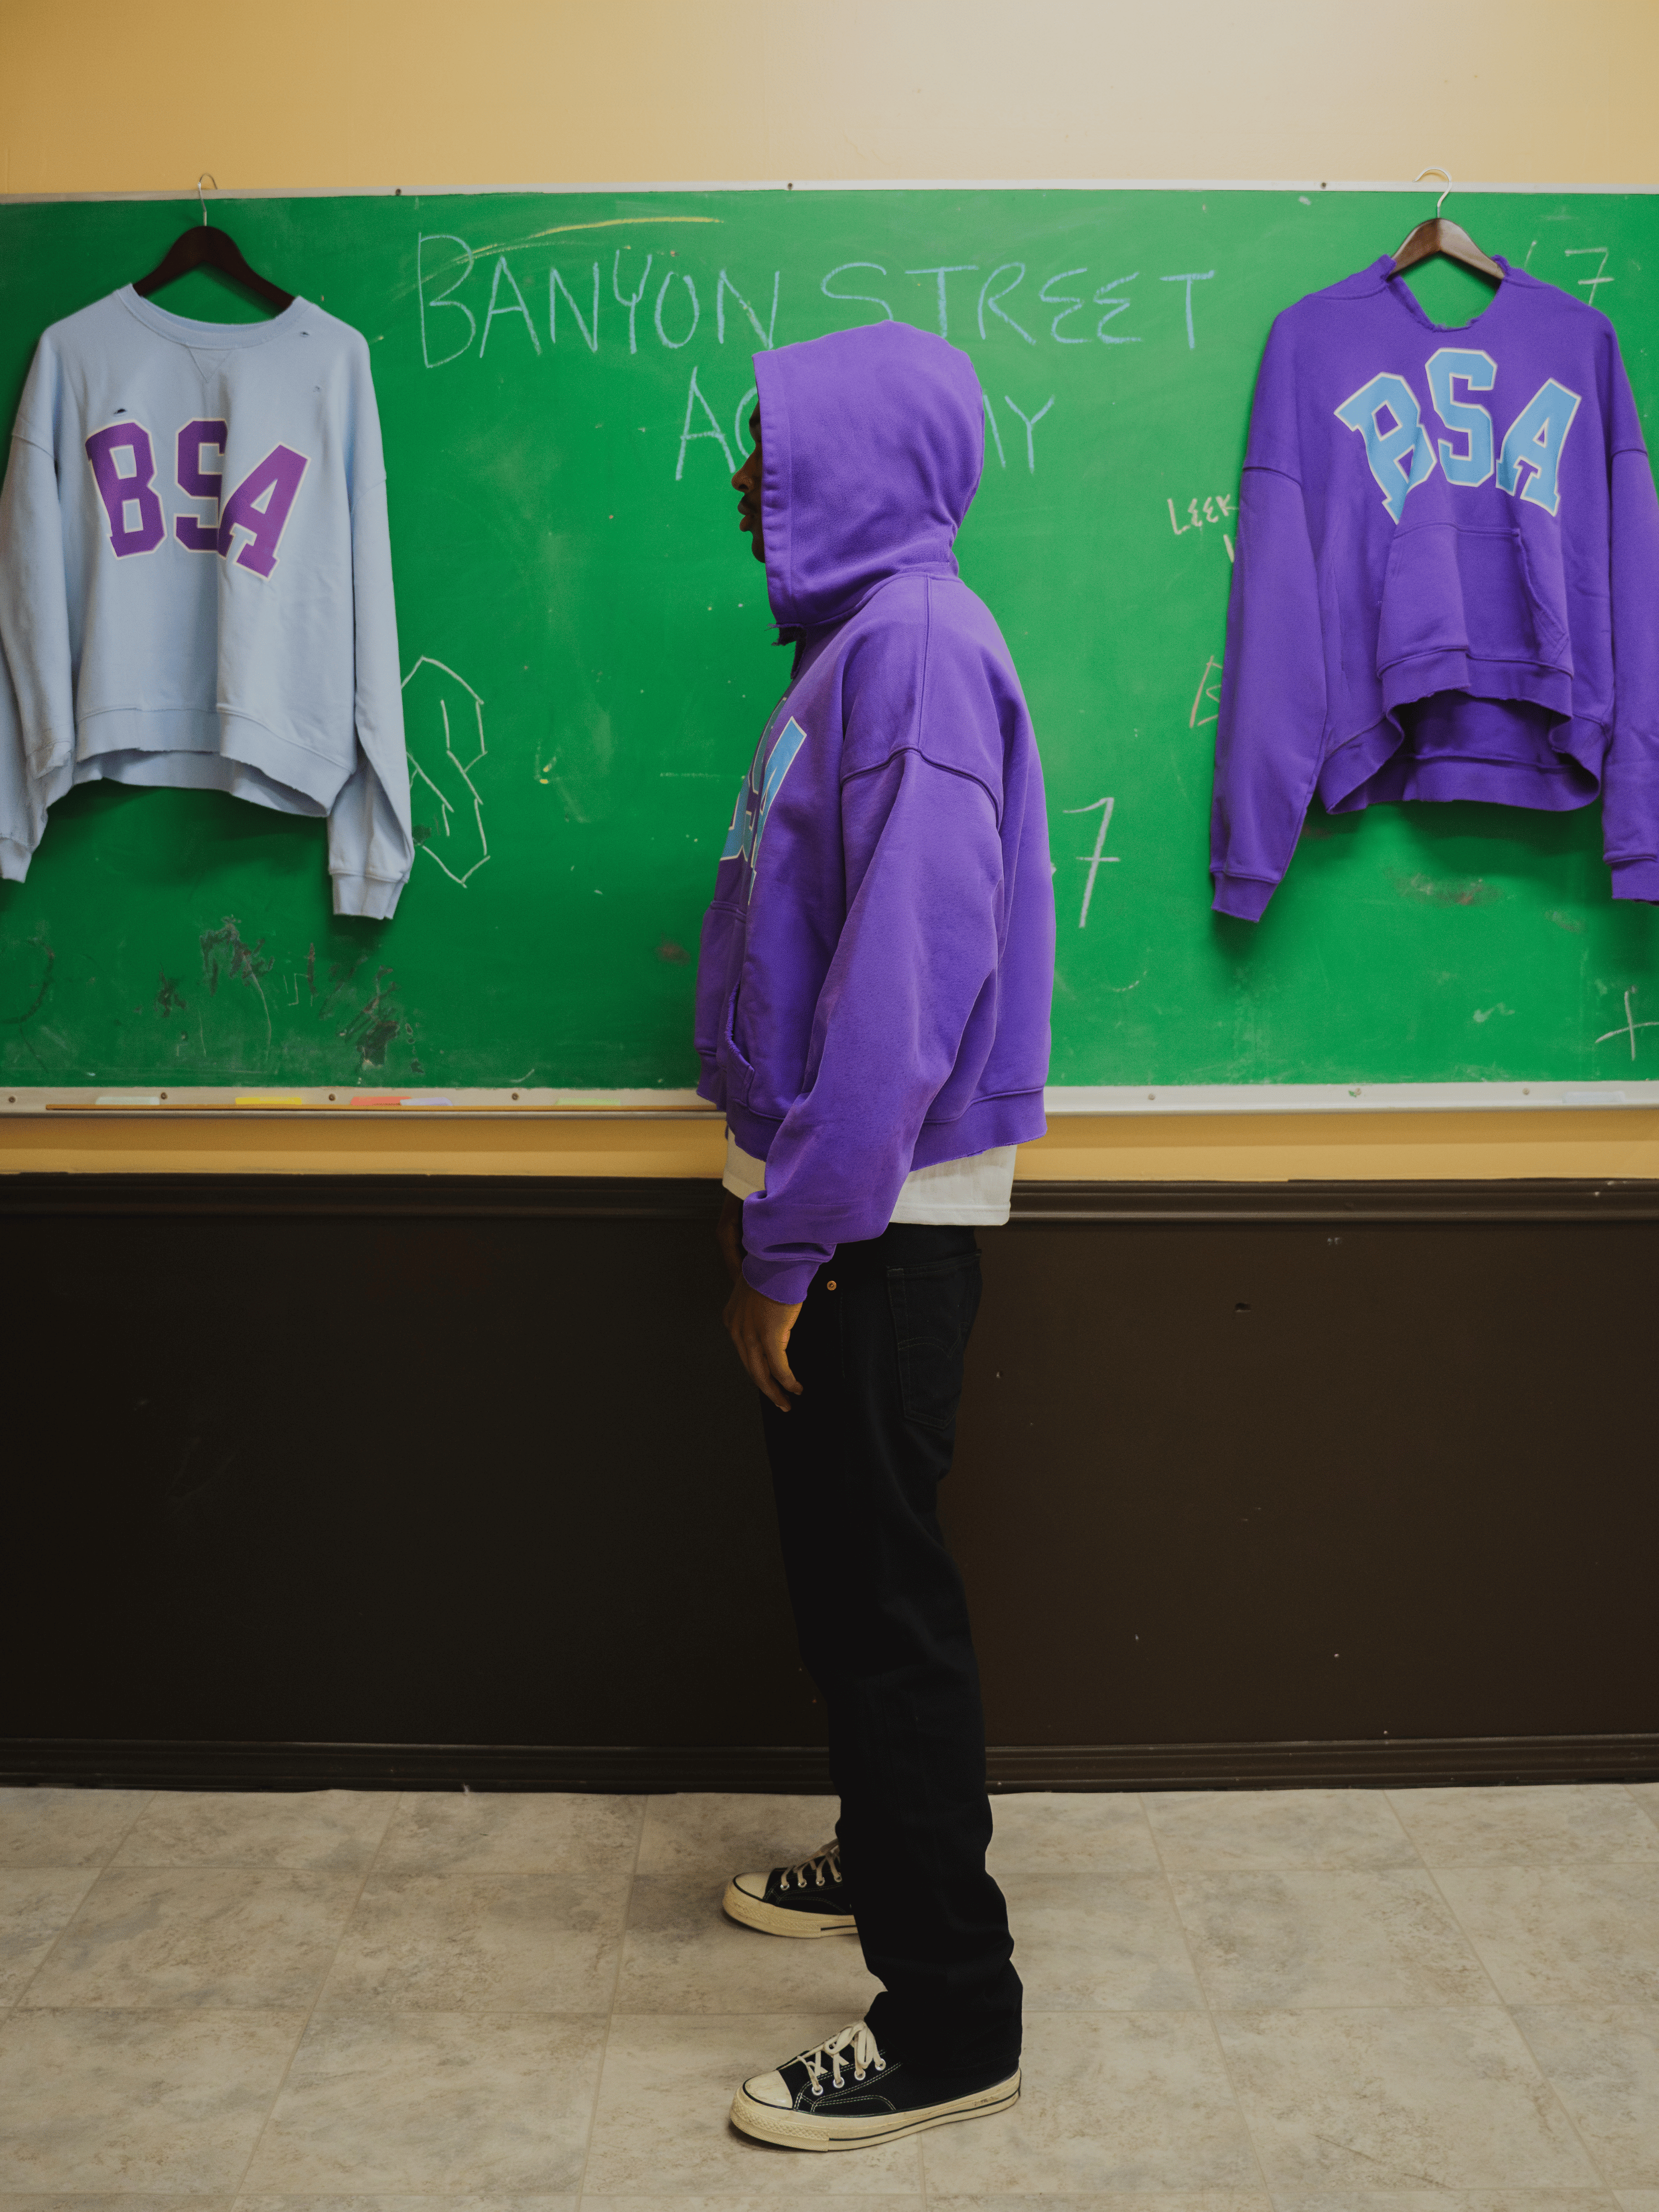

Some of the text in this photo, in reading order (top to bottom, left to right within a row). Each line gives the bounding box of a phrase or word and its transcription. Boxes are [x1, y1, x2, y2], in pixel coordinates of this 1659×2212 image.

[417, 232, 1216, 368] BANYON STREET
[84, 417, 312, 582] BSA
[1334, 347, 1582, 526] BSA
